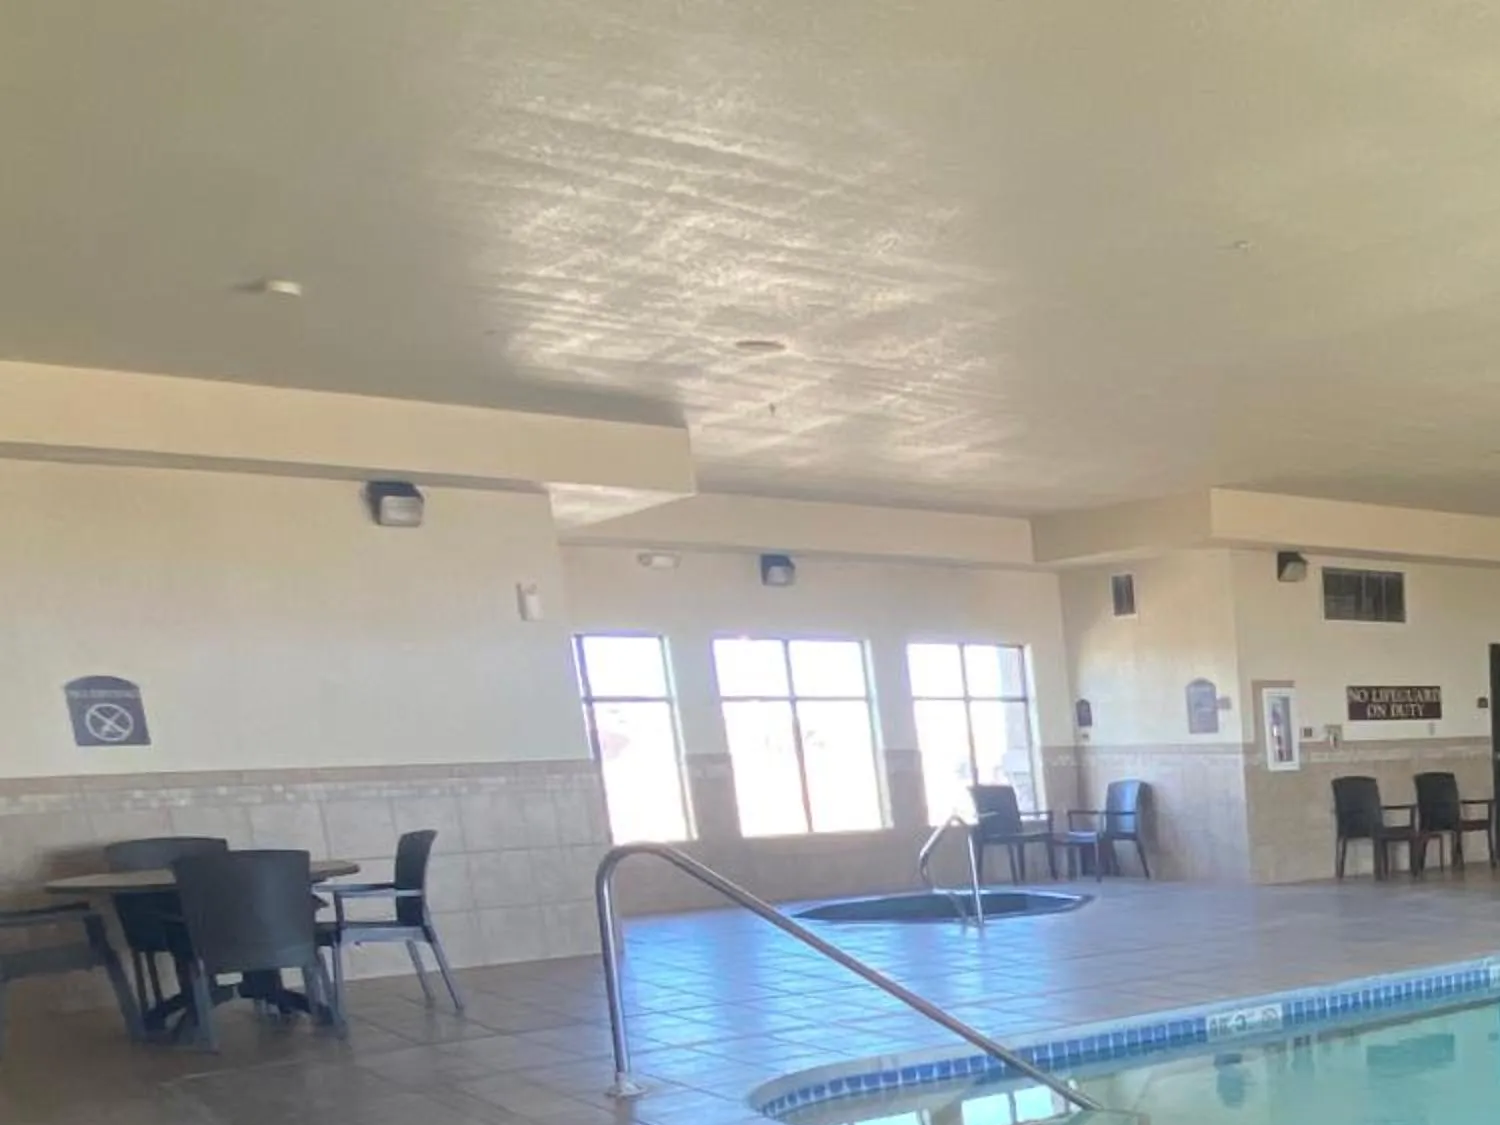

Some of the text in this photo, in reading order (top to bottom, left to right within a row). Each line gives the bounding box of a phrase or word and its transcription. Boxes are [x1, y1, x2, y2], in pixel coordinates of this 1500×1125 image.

[1347, 688, 1369, 703] NO
[1367, 703, 1425, 718] ON DUTY
